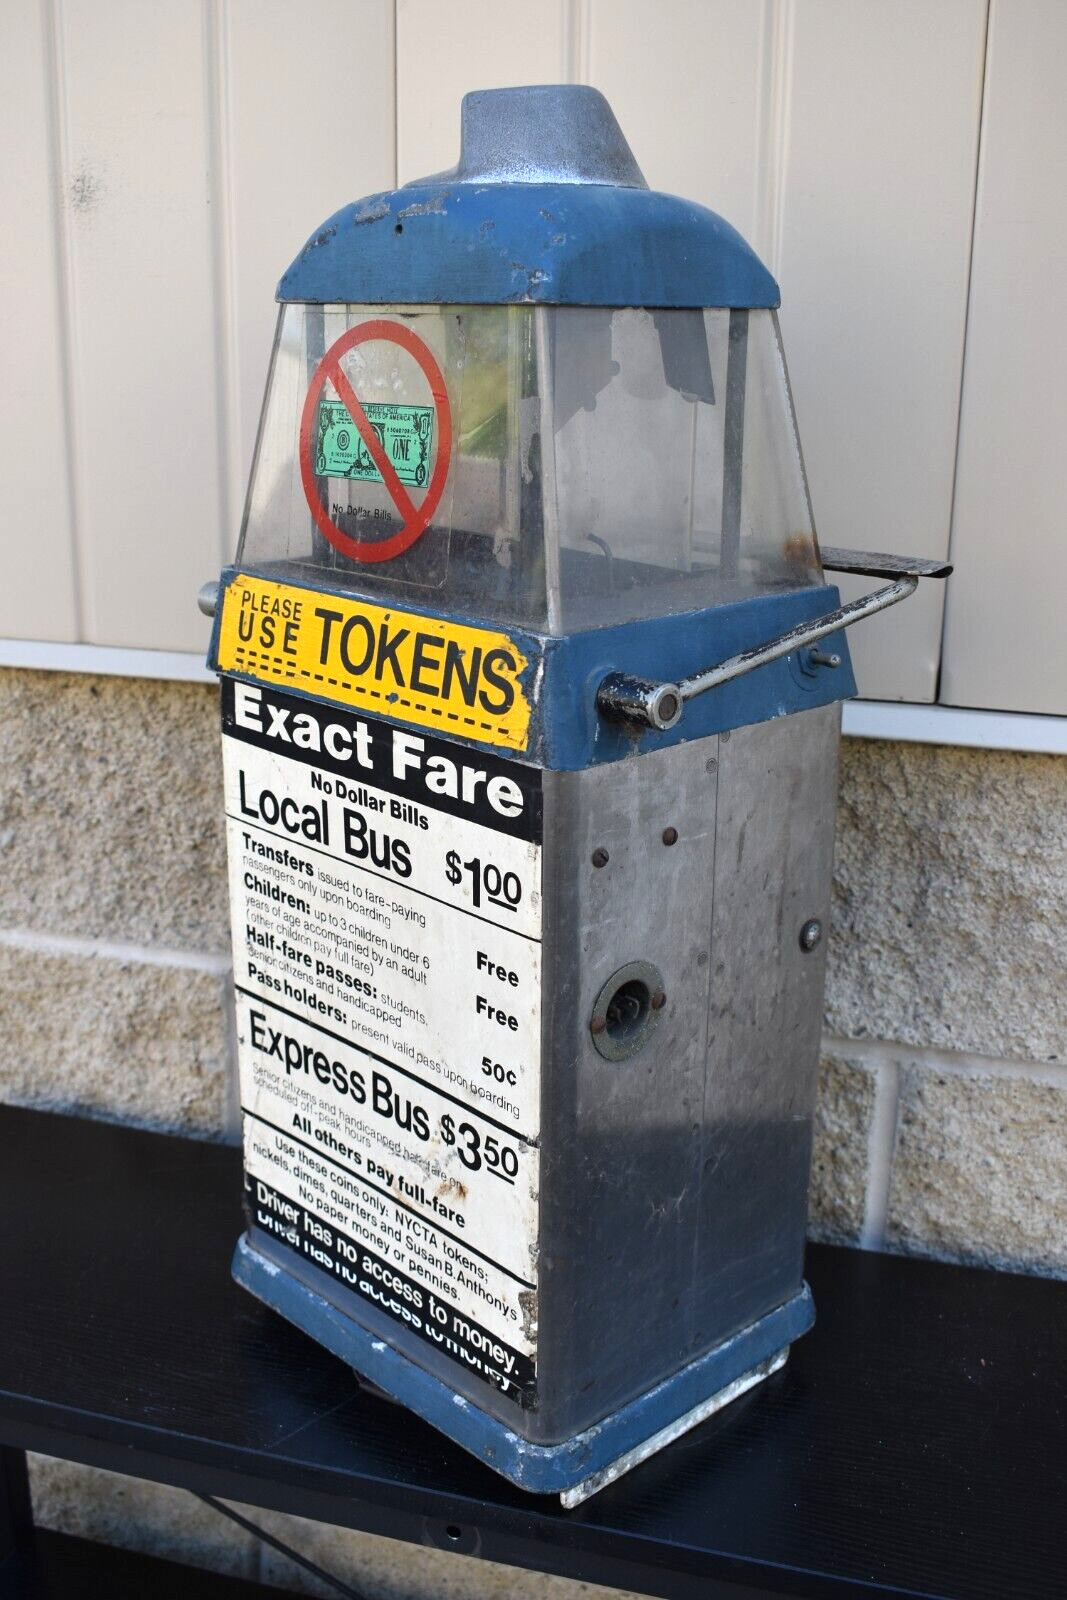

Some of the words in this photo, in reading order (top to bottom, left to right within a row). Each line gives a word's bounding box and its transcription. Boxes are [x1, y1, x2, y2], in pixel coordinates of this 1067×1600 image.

[392, 438, 411, 461] ONE
[333, 503, 344, 513] No
[347, 505, 371, 516] Dollar
[375, 508, 391, 520] Bills
[241, 590, 303, 622] PLEASE
[238, 609, 300, 656] USE
[314, 607, 517, 716] TOKENS
[234, 681, 374, 770] Exact
[392, 729, 524, 818] Fare
[310, 770, 333, 795] No
[336, 777, 386, 814] Dollar
[390, 798, 429, 831] Bills
[238, 769, 330, 846] Local
[343, 807, 413, 878] Bus
[242, 831, 314, 877] Transfers
[318, 867, 350, 892] issued
[352, 883, 363, 898] to
[365, 888, 426, 928] fare-paying
[242, 855, 295, 886] passengers
[297, 879, 318, 897] only
[320, 888, 345, 907] upon
[346, 896, 391, 930] boarding
[244, 872, 311, 915] Children:
[314, 909, 327, 923] up
[328, 913, 339, 927] to
[340, 917, 347, 931] 3
[348, 923, 388, 950] children
[390, 942, 420, 962] under
[422, 955, 430, 970] 6
[476, 950, 520, 988] Free
[245, 895, 270, 913] years
[271, 905, 281, 917] of
[283, 911, 301, 928] age
[303, 920, 369, 958] accompanied
[371, 950, 384, 966] by
[386, 958, 399, 971] an
[401, 964, 427, 985] adult
[246, 924, 312, 968] Half-fare
[315, 959, 377, 999] passes:
[476, 994, 519, 1032] Free
[276, 923, 312, 946] children
[314, 941, 332, 957] pay
[334, 946, 349, 965] full
[351, 955, 374, 977] fare)
[248, 961, 282, 992] Pass
[284, 979, 347, 1024] holders:
[351, 1019, 389, 1045] present
[392, 1039, 415, 1059] valid
[417, 1051, 441, 1074] pass
[443, 1068, 468, 1090] upon
[469, 1079, 520, 1120] boarding
[278, 960, 314, 985] citizens
[316, 977, 334, 995] and
[336, 986, 402, 1028] handicapped
[249, 1009, 367, 1104] Express
[372, 1070, 430, 1142] Bus
[253, 1074, 299, 1108] scheduled
[300, 1100, 341, 1130] off-peak
[344, 1124, 372, 1149] hours
[283, 1079, 317, 1105] citizens
[318, 1097, 336, 1116] and
[338, 1106, 401, 1153] handicapped
[481, 1056, 517, 1088] 50¢
[275, 1135, 296, 1158] Use
[298, 1150, 328, 1177] these
[330, 1171, 360, 1197] coins
[395, 1209, 438, 1249] NYCTA
[292, 1113, 312, 1135] All
[314, 1128, 362, 1165] others
[367, 1158, 394, 1187] pay
[398, 1175, 466, 1228] full-fare
[253, 1142, 292, 1174] nickels,
[293, 1165, 328, 1198] dimes,
[330, 1188, 378, 1227] quarters
[380, 1220, 402, 1243] and
[405, 1235, 443, 1271] Susan
[456, 1270, 518, 1321] Anthonys
[256, 1181, 300, 1225] Driver
[304, 1211, 333, 1247] has
[336, 1238, 358, 1263] no
[362, 1255, 423, 1309] access
[428, 1295, 448, 1325] to
[453, 1316, 520, 1376] money.
[299, 1184, 314, 1203] No
[316, 1197, 349, 1225] paper
[351, 1221, 390, 1255] money
[393, 1249, 405, 1263] or
[408, 1258, 461, 1301] pennies.
